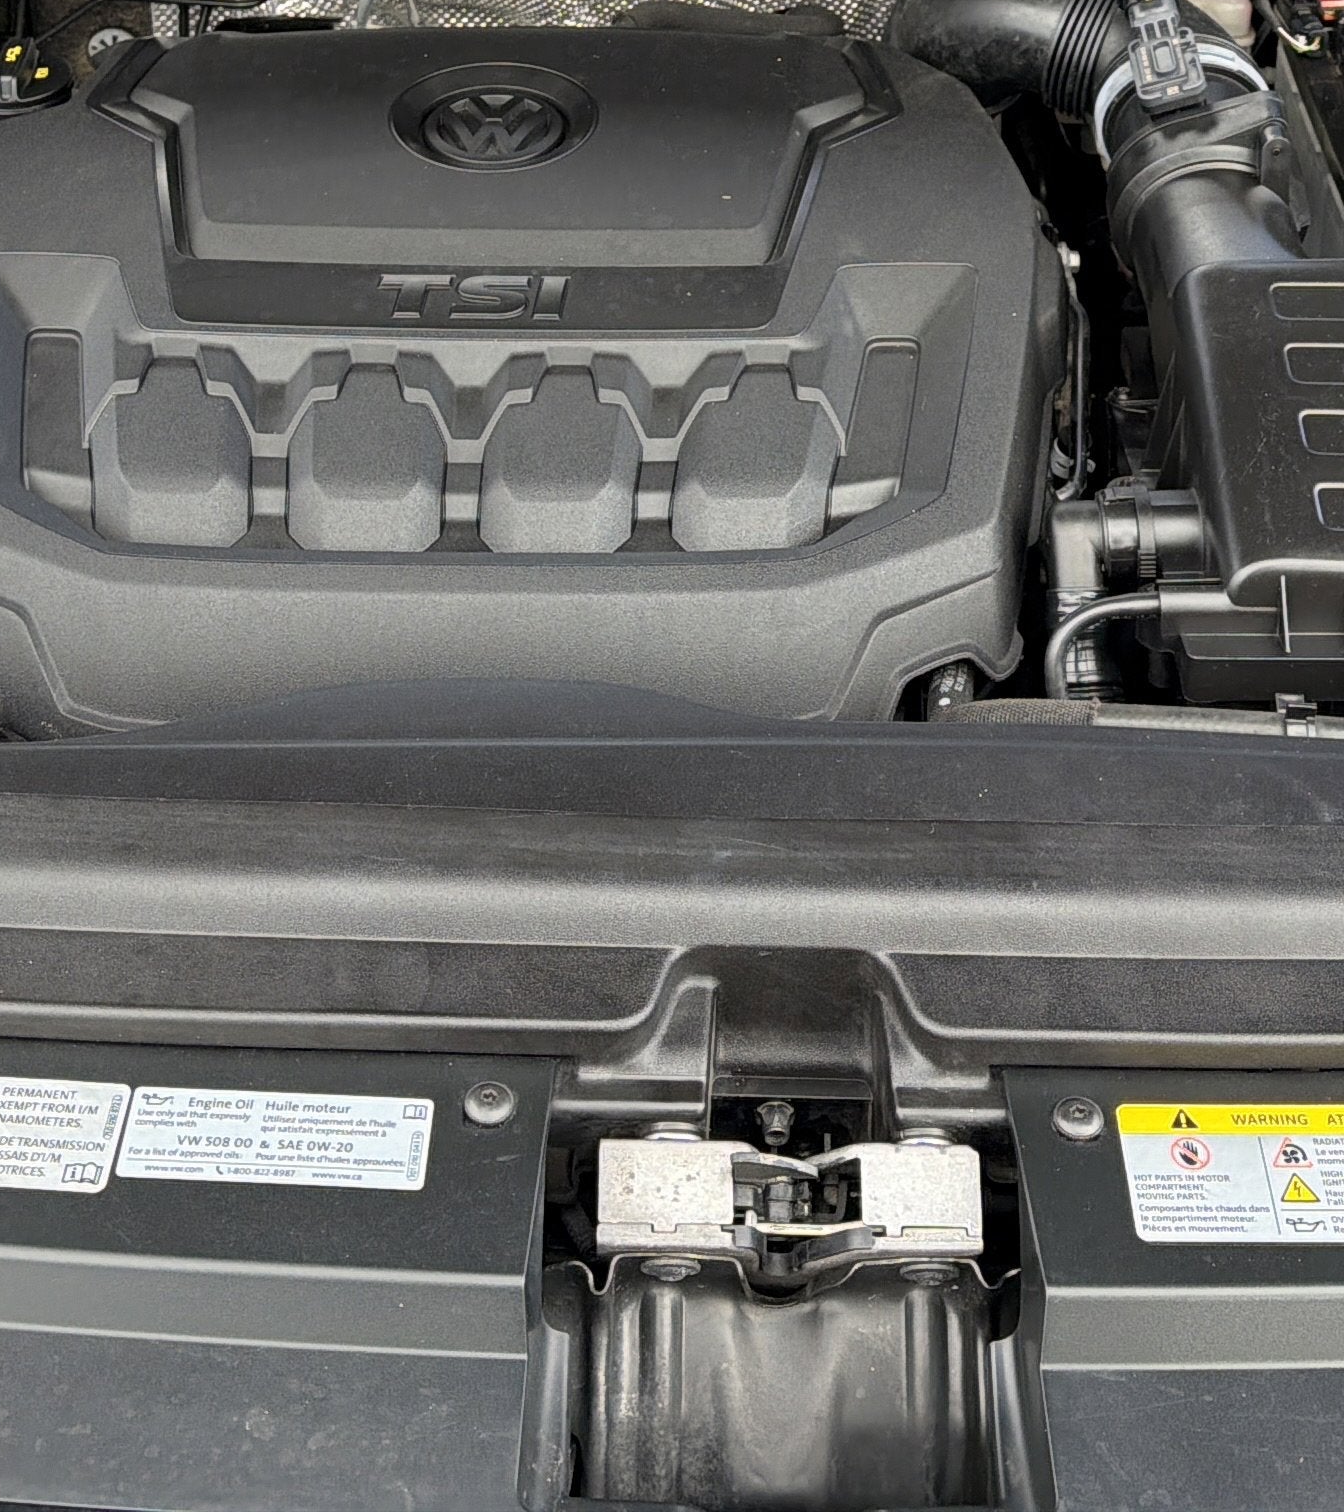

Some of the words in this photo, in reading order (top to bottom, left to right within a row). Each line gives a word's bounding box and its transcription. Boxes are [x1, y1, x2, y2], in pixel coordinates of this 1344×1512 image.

[378, 274, 571, 320] TSI
[3, 1086, 78, 1101] PERMANENT
[42, 1102, 76, 1114] FROM
[188, 1097, 232, 1110] Engine
[236, 1099, 254, 1110] Oil
[266, 1100, 299, 1112] Huile
[302, 1103, 352, 1114] moteur
[156, 1111, 174, 1119] only
[177, 1110, 188, 1118] oil
[190, 1110, 208, 1119] that
[210, 1112, 251, 1122] expressly
[262, 1114, 296, 1124] Utilisez
[298, 1117, 354, 1127] uniquement
[356, 1118, 367, 1126] de
[369, 1119, 396, 1128] l'huile
[1231, 1114, 1308, 1126] WARNING
[135, 1118, 174, 1128] complies
[176, 1120, 197, 1128] with
[260, 1125, 276, 1133] qui
[278, 1125, 314, 1134] satisfait
[316, 1127, 379, 1138] expressément
[380, 1129, 387, 1137] à
[2, 1136, 15, 1147] DE
[17, 1137, 105, 1152] TRANSMISSION
[176, 1134, 202, 1146] VW
[205, 1136, 230, 1147] 508
[234, 1138, 254, 1148] 00
[260, 1140, 270, 1148] &
[278, 1140, 304, 1150] SAE
[306, 1141, 354, 1152] 0W-20
[128, 1146, 143, 1154] For
[152, 1147, 166, 1156] list
[168, 1148, 178, 1156] of
[179, 1149, 222, 1160] approved
[1316, 1148, 1326, 1156] Le
[296, 1154, 314, 1162] liste
[316, 1156, 350, 1164] d'huiles
[1134, 1174, 1152, 1182] HOT
[1155, 1174, 1184, 1182] PARTS
[1320, 1170, 1344, 1178] HIGH
[1137, 1192, 1174, 1200] MOVING
[1196, 1204, 1213, 1212] très
[1216, 1204, 1248, 1212] chauds
[1249, 1204, 1270, 1212] dans
[1141, 1214, 1150, 1222] le
[1152, 1214, 1218, 1224] compartiment
[1142, 1224, 1172, 1232] Pièces
